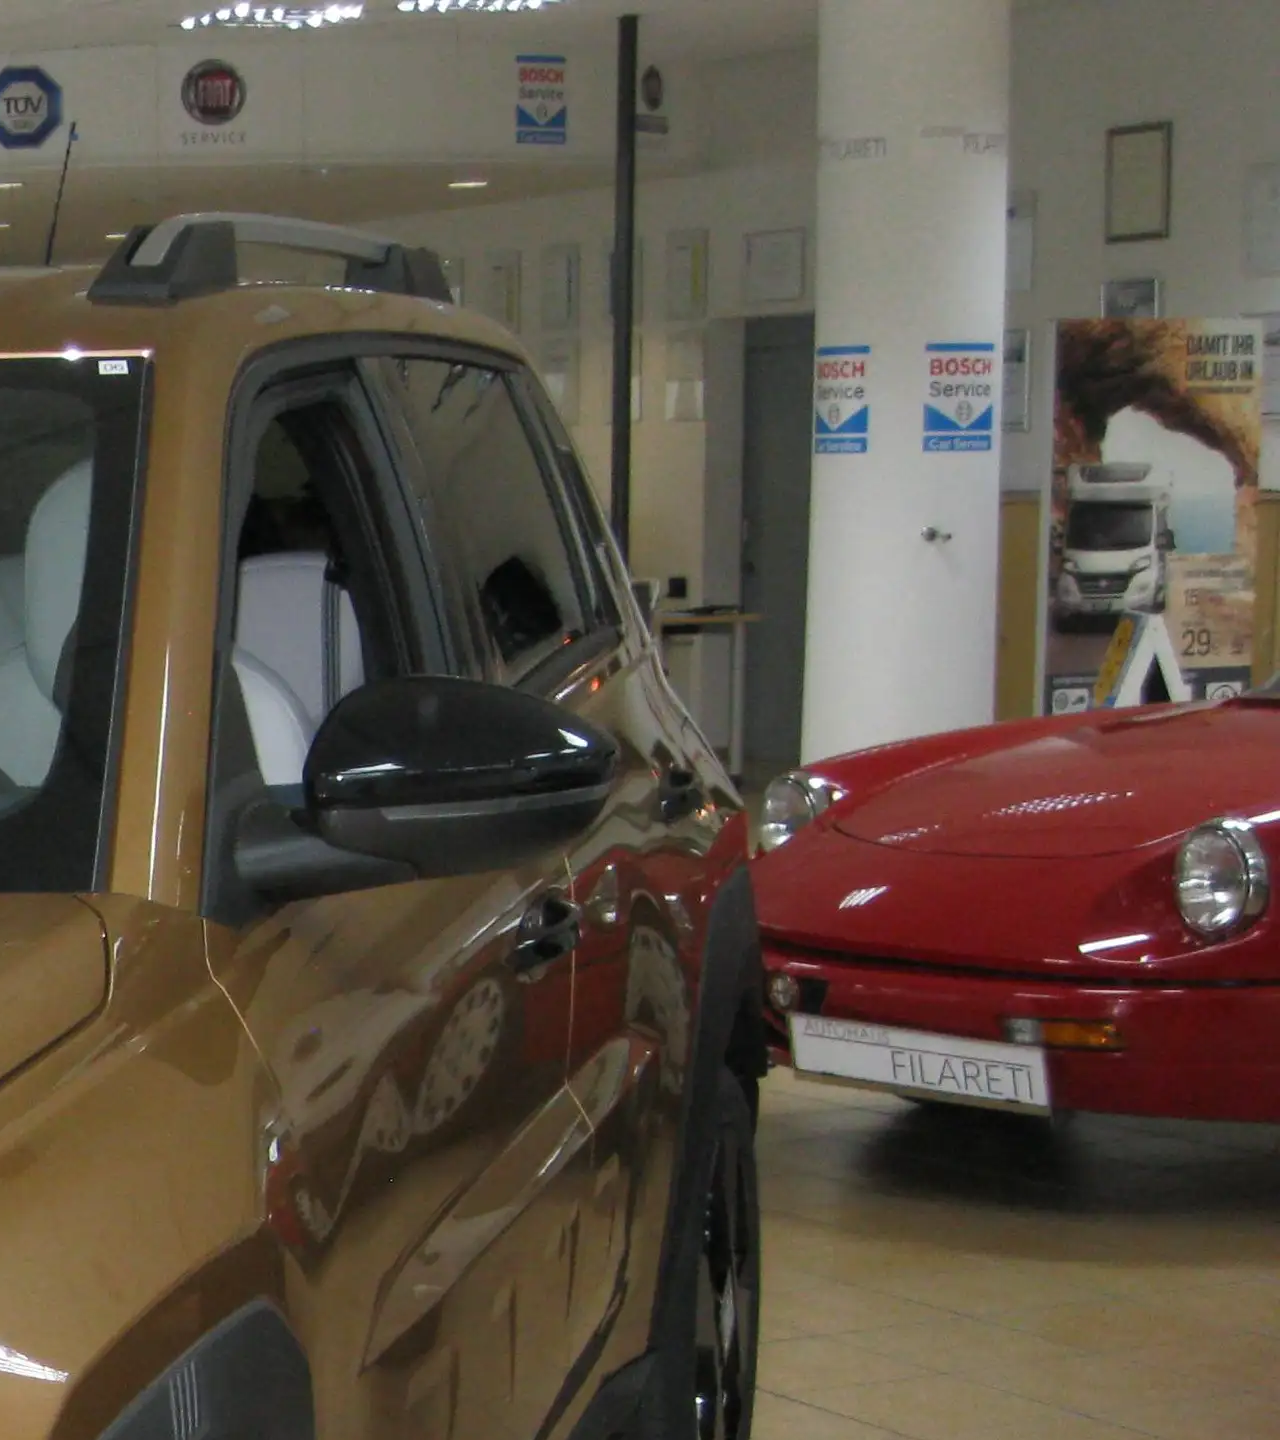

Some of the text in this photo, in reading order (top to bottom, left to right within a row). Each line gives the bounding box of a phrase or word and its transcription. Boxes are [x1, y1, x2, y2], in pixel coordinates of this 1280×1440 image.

[520, 68, 565, 84] BOSCH
[520, 87, 564, 100] Service
[1186, 334, 1227, 355] DAMIT
[929, 358, 991, 377] BOSCH
[929, 381, 991, 398] Service
[1180, 628, 1211, 656] 29
[802, 1017, 890, 1044] AUTOHAUS
[889, 1050, 1034, 1100] FILARETI
